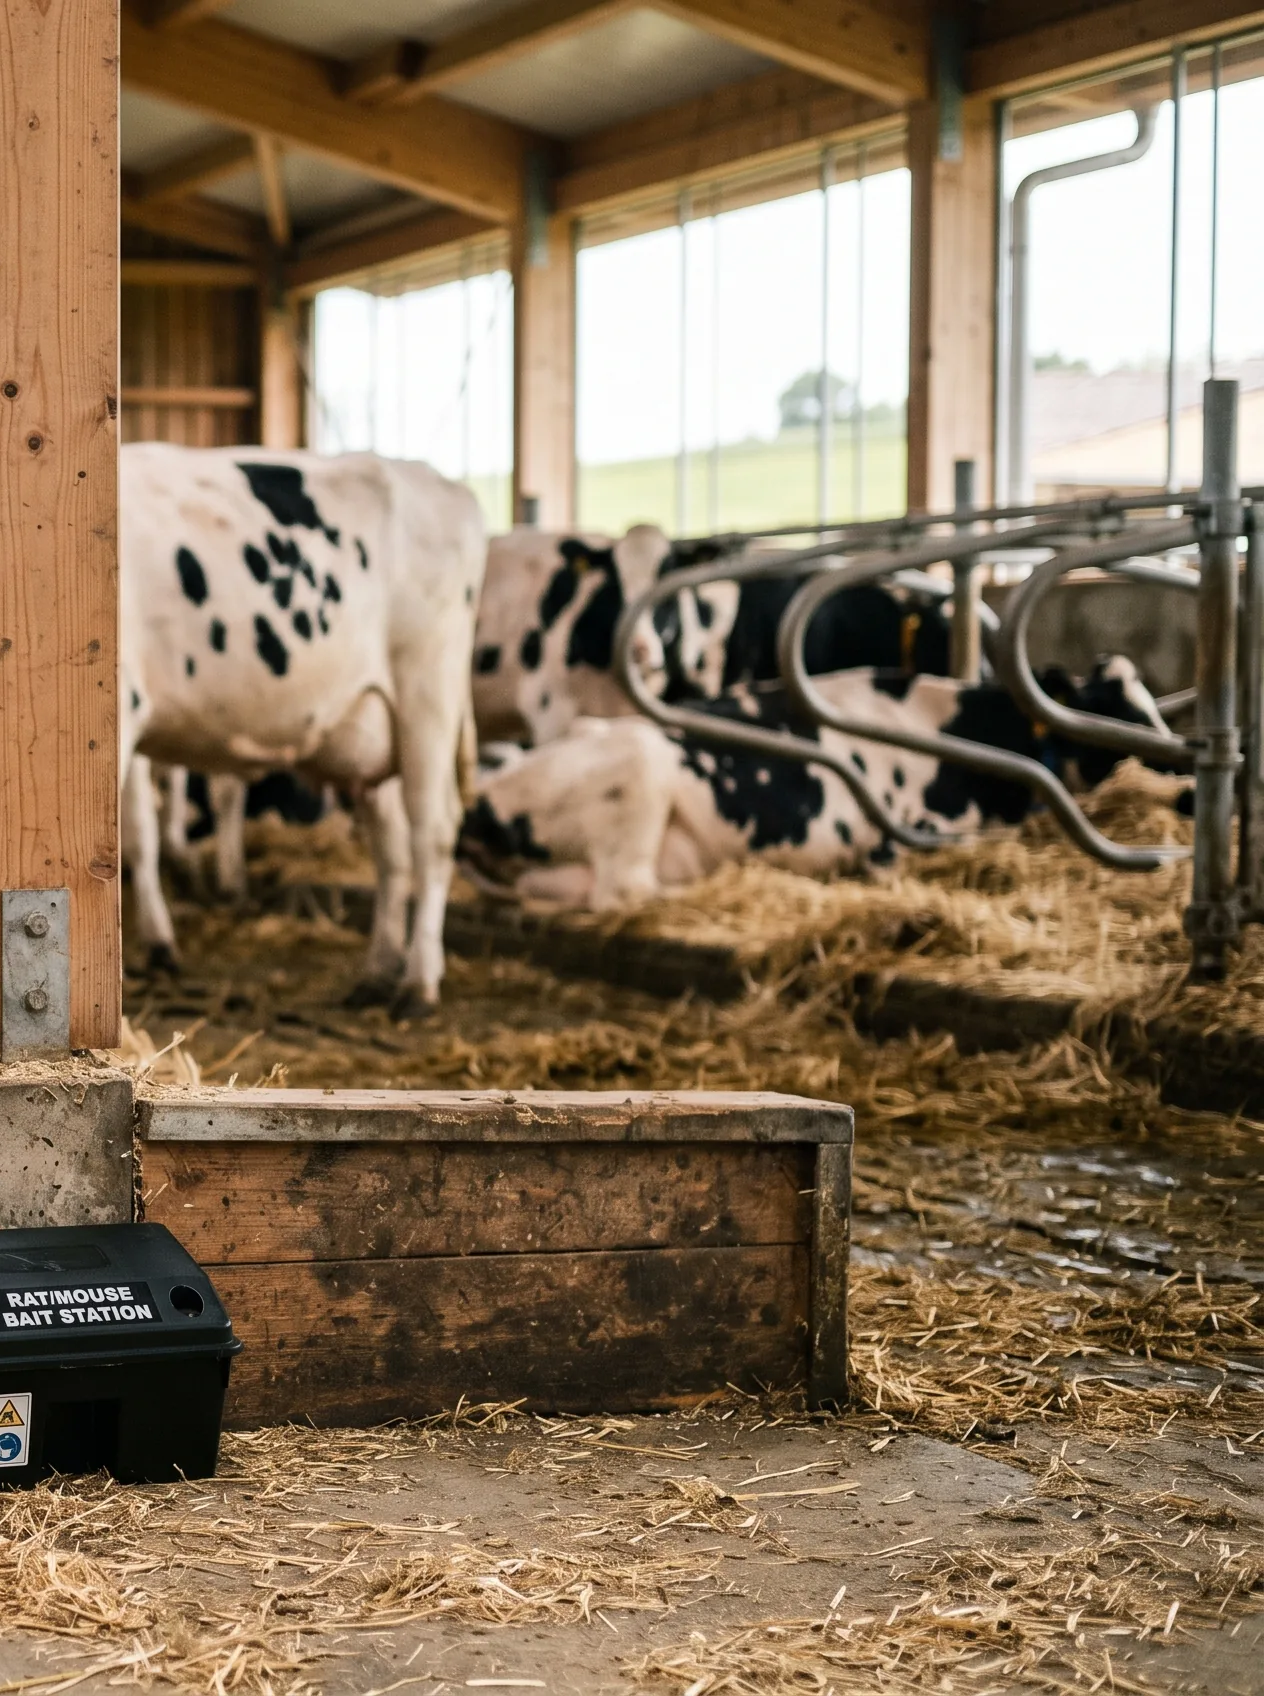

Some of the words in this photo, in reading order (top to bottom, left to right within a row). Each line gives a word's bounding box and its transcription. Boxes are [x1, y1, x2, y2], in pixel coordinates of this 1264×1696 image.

[6, 1286, 134, 1308] RAT/MOUSE
[2, 1310, 54, 1328] BAIT
[59, 1304, 153, 1324] STATION
